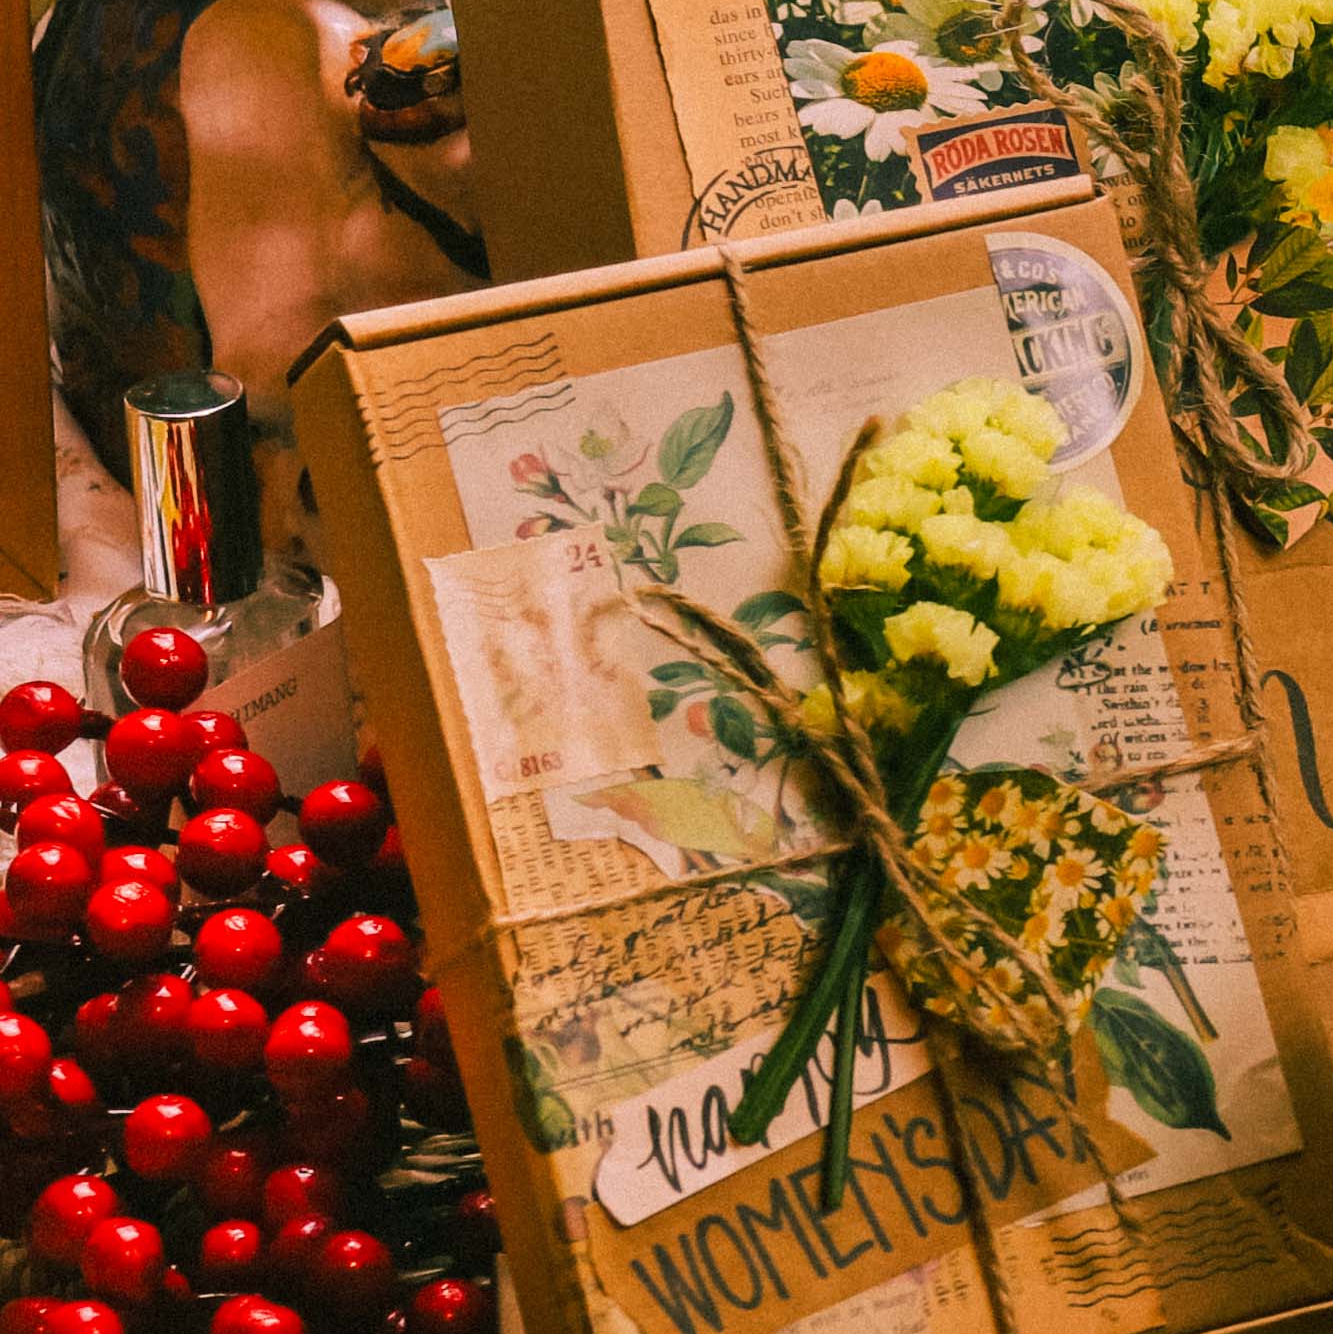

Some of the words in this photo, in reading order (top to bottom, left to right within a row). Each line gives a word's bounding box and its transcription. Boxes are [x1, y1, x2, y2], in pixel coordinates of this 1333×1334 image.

[714, 27, 756, 46] since
[734, 109, 779, 127] bears
[740, 129, 781, 149] most
[930, 137, 993, 181] RÖDA
[993, 126, 1067, 159] ROSEN
[953, 163, 1056, 194] SÄKERHETS
